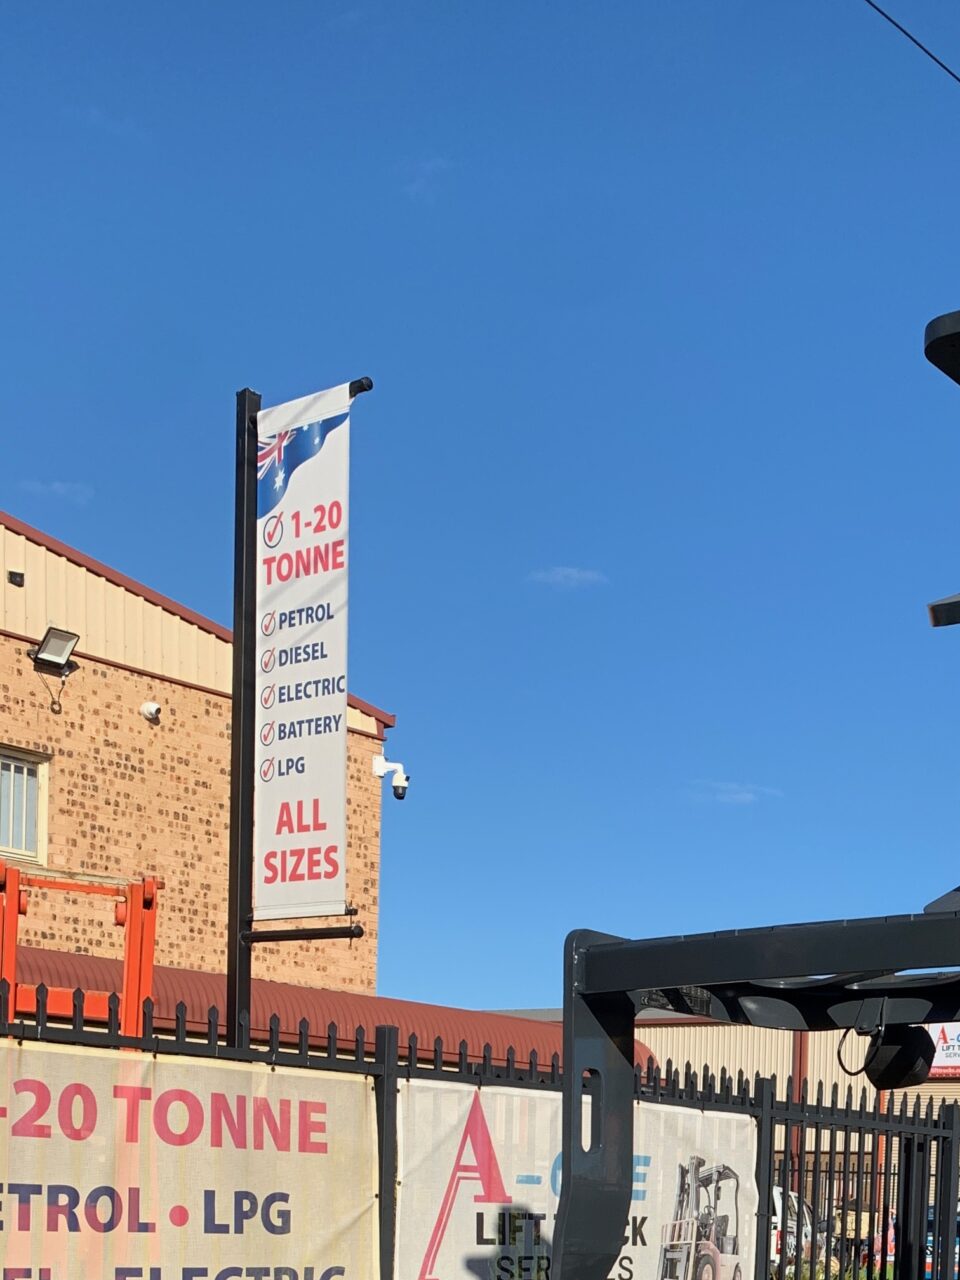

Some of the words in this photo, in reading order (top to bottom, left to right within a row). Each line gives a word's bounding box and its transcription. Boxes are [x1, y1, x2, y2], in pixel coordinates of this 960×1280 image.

[290, 500, 342, 540] 1-20
[262, 539, 345, 586] TONNE
[278, 603, 334, 630] PETROL
[278, 641, 328, 667] DIESEL
[278, 674, 346, 703] ELECTRIC
[277, 713, 342, 740] BATTERY
[277, 756, 306, 777] LPG
[275, 798, 327, 835] ALL
[263, 845, 340, 884] SIZES
[113, 1084, 329, 1155] TONNE
[0, 1183, 156, 1233] TROL
[203, 1189, 292, 1235] LPG
[476, 1211, 546, 1246] LIFT
